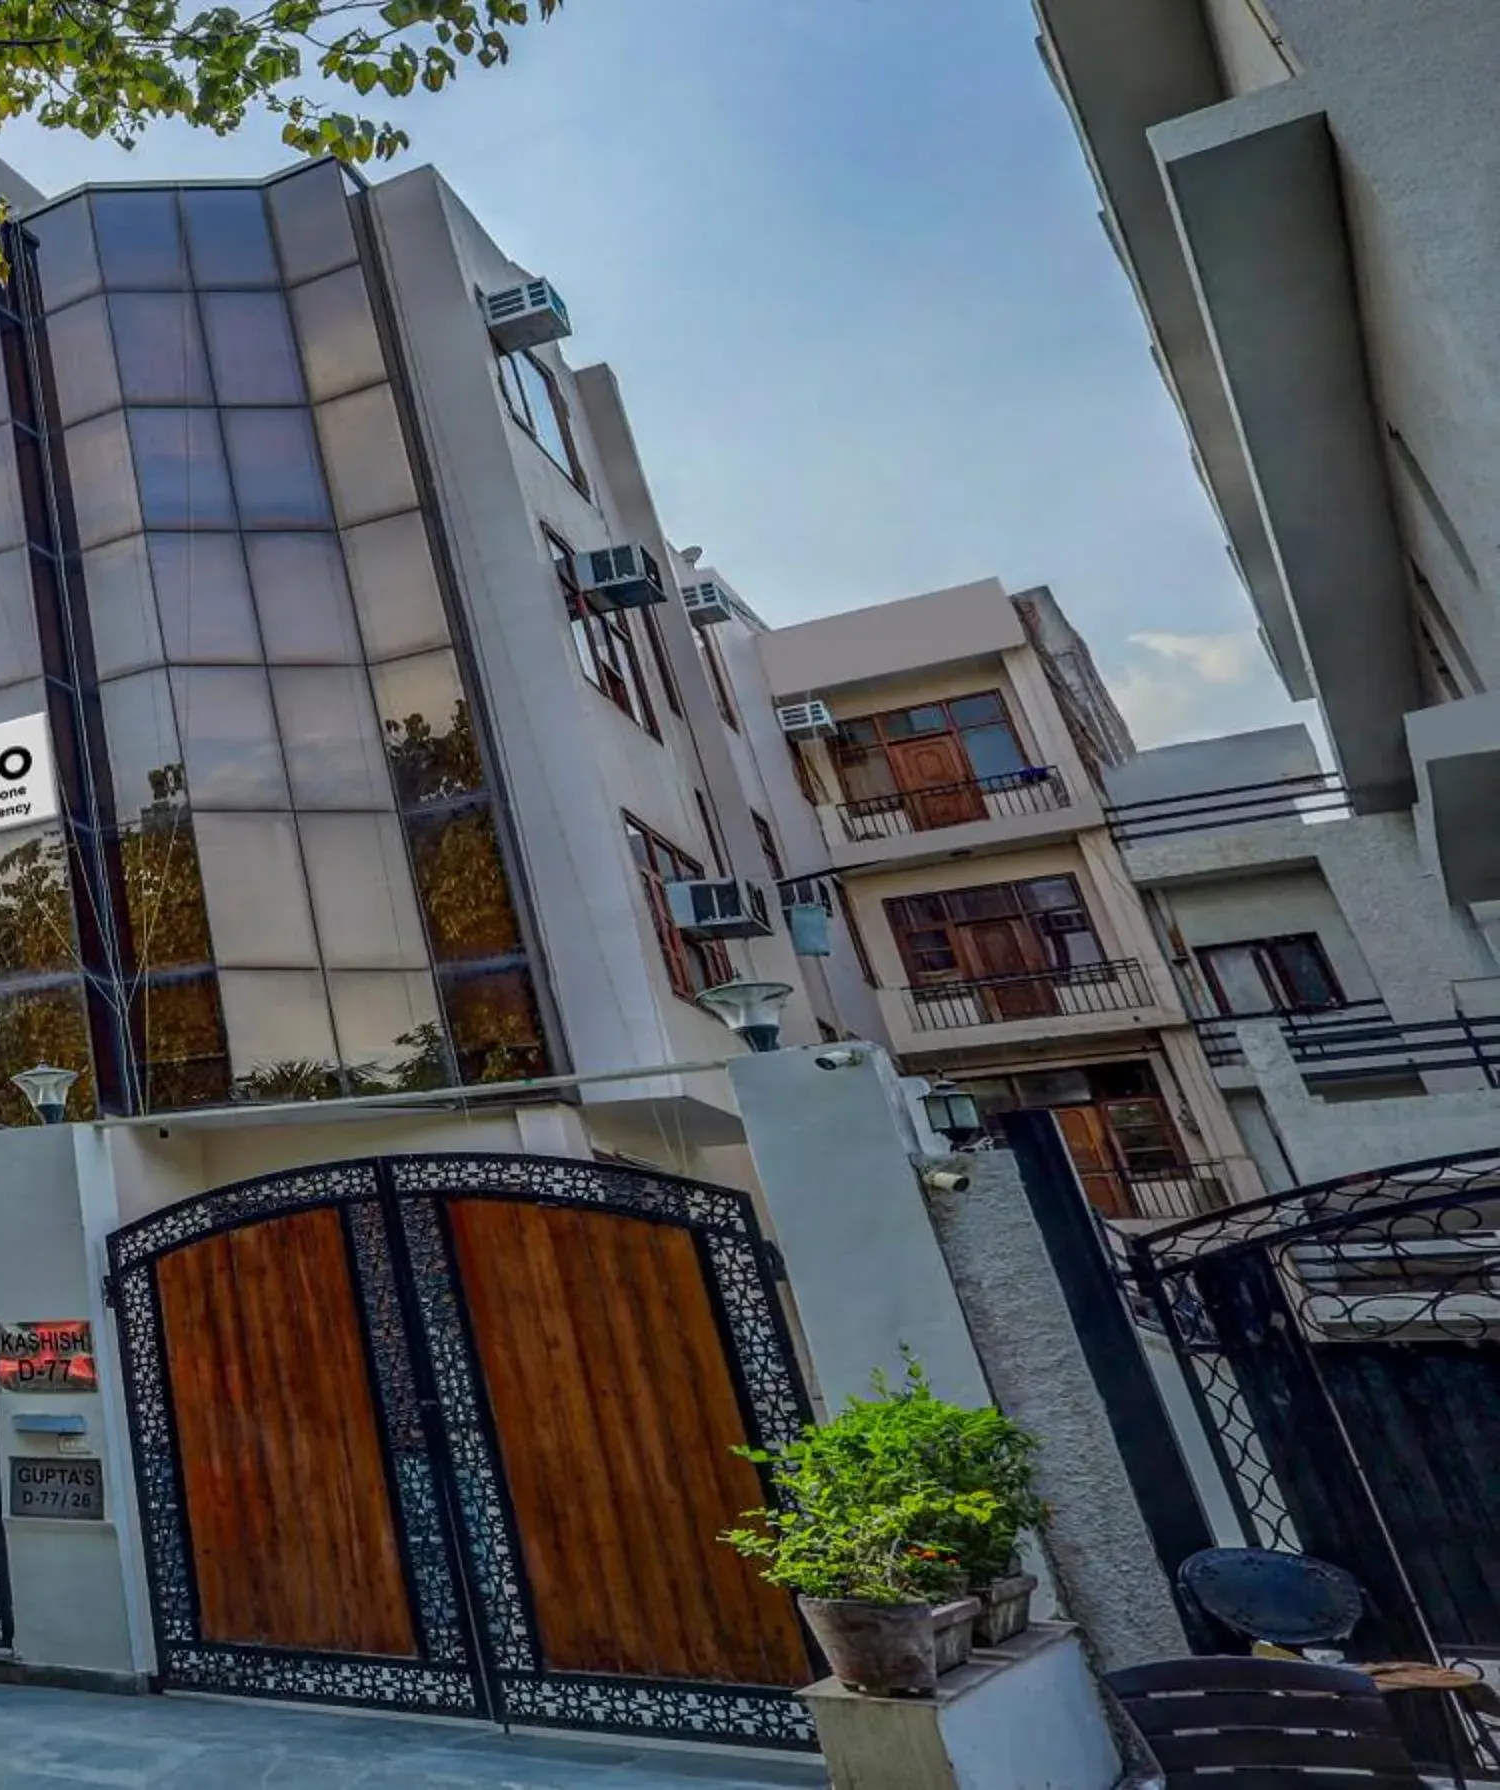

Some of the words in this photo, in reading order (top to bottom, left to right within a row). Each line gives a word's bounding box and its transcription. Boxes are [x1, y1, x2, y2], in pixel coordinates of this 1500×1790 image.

[0, 1330, 86, 1353] KASHISH
[18, 1358, 72, 1382] D-77
[18, 1466, 96, 1486] GUPTA'S
